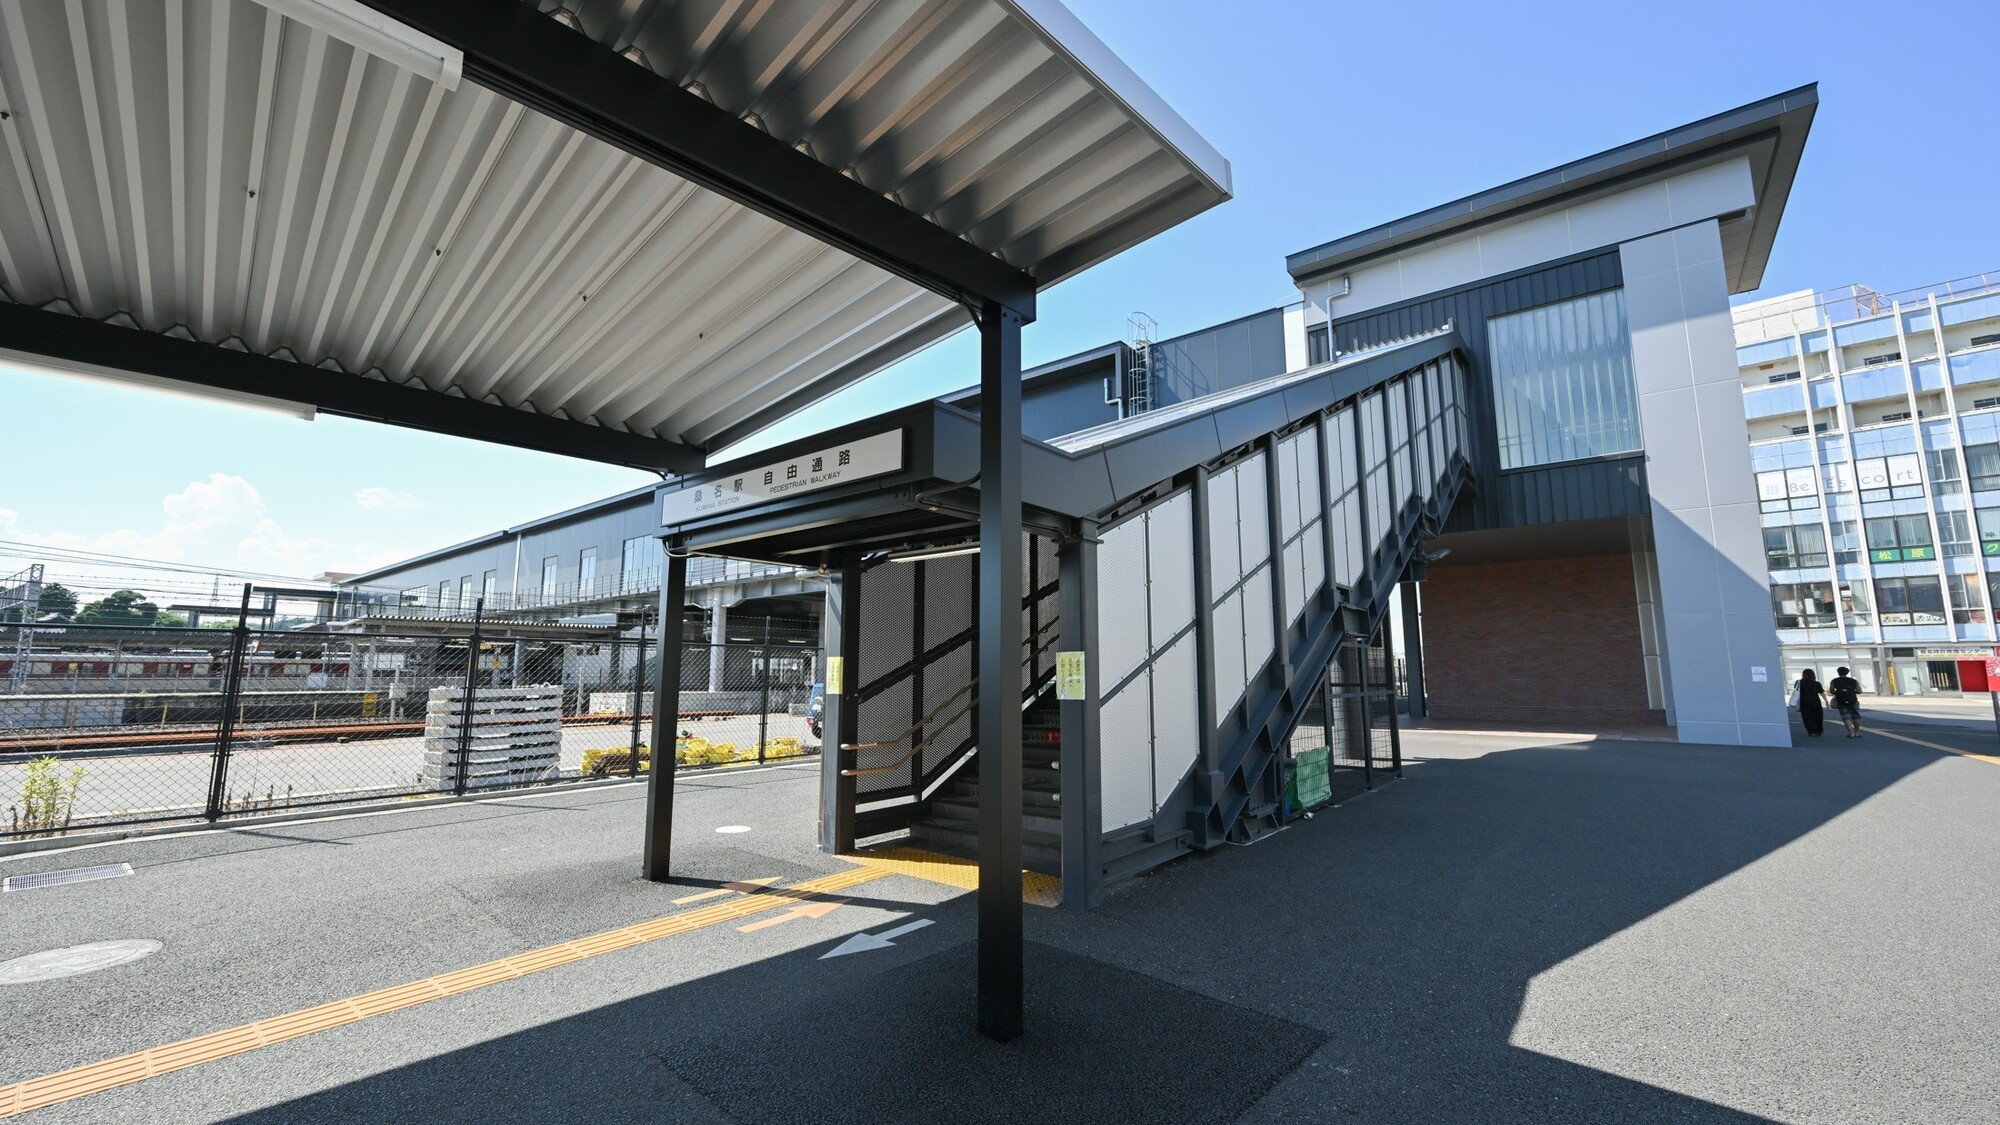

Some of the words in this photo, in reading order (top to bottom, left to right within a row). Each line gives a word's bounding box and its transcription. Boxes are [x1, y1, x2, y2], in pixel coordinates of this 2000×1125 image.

[694, 478, 743, 504] 桑名駅
[763, 449, 851, 486] 自由通路
[718, 496, 740, 507] STATION
[769, 479, 808, 494] PEDESTRIAN
[810, 470, 842, 484] WALKWAY
